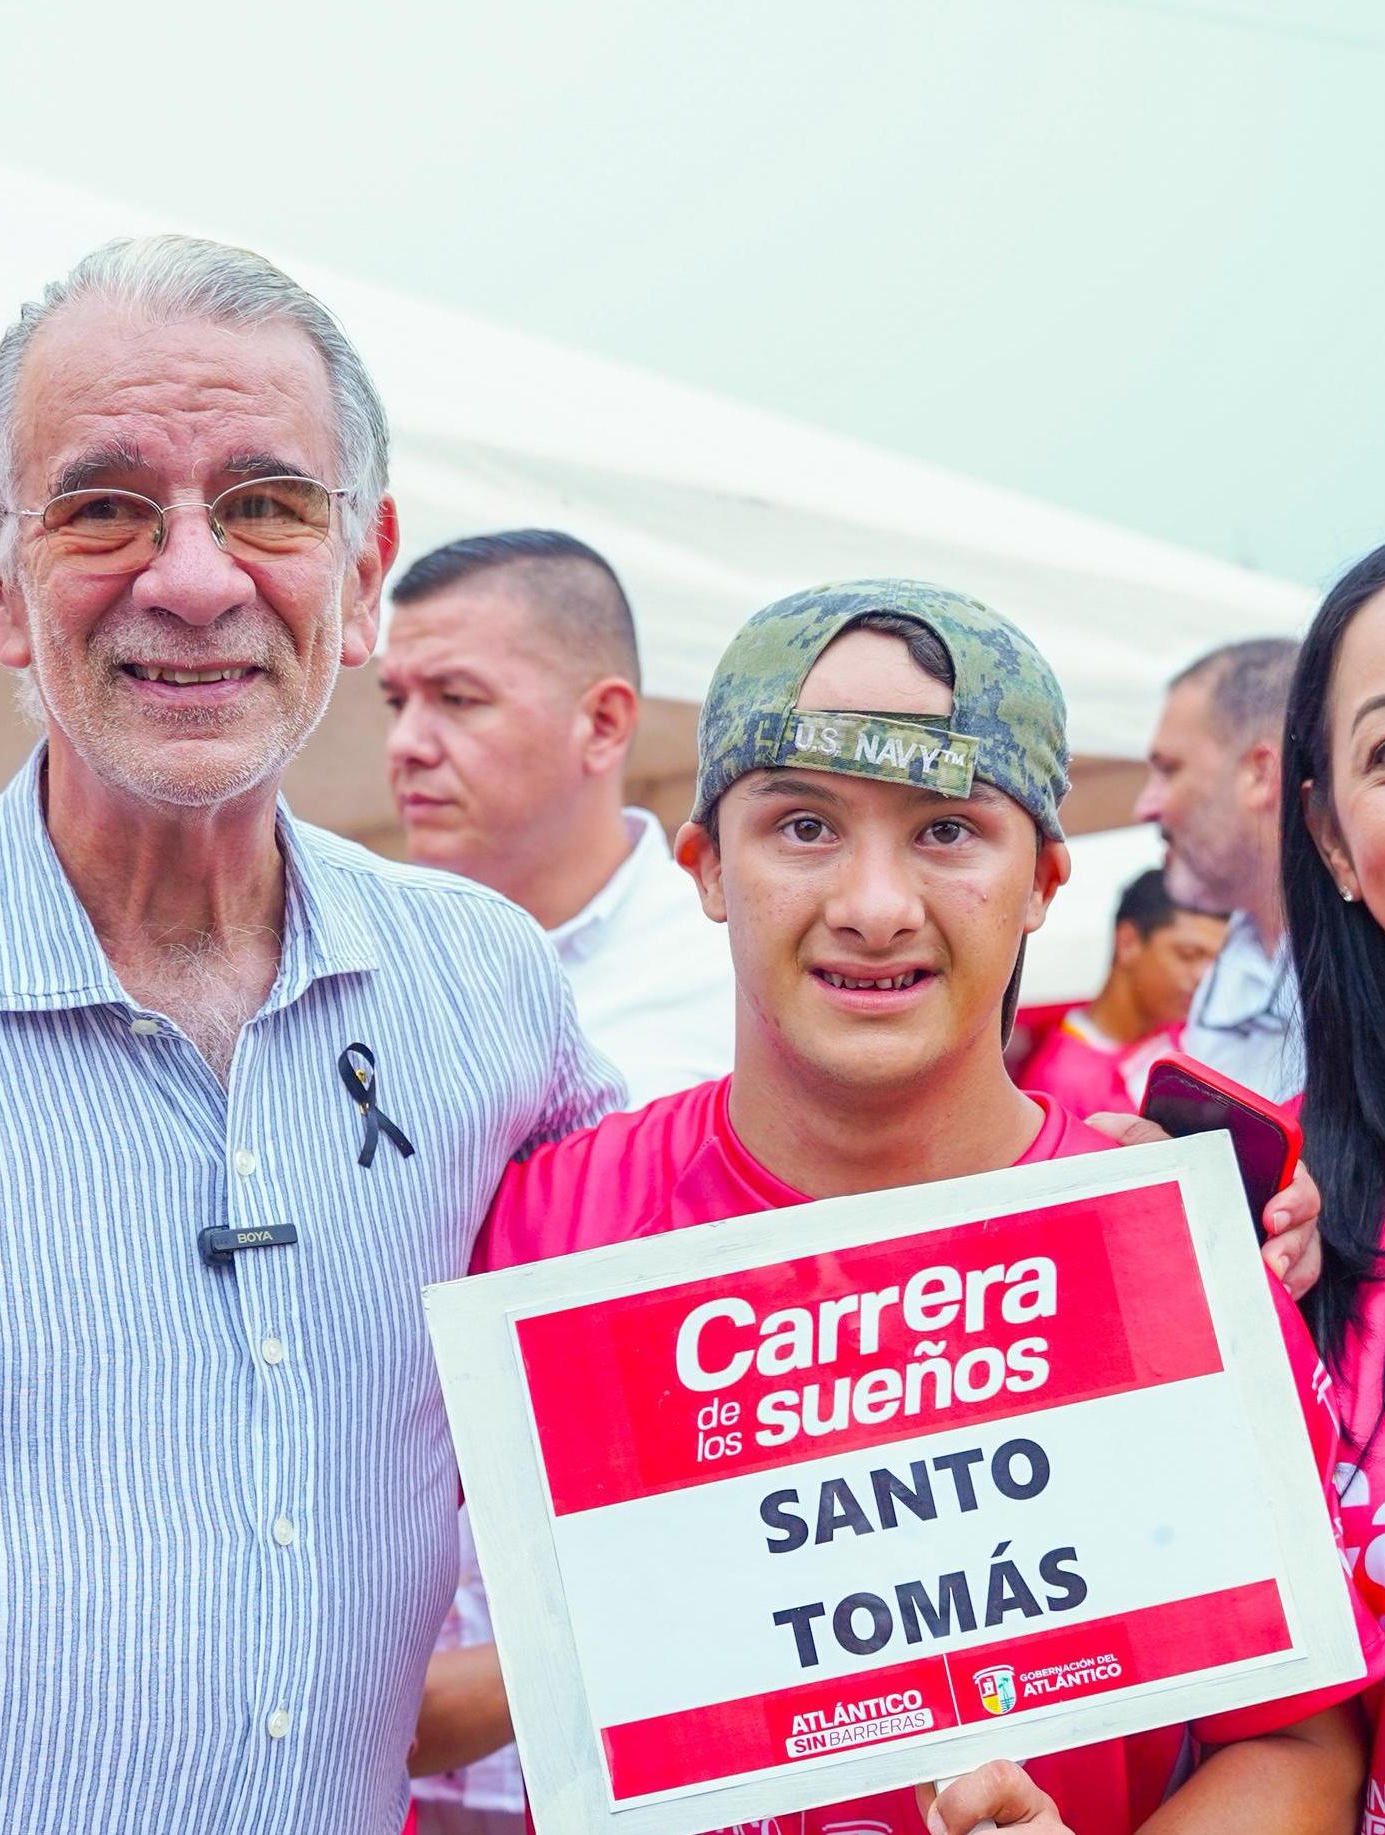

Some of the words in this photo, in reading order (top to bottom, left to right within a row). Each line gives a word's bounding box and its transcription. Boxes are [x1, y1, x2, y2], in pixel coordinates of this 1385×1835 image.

[795, 723, 842, 757] U.S.
[237, 1230, 274, 1244] BOYA
[675, 1256, 1058, 1393] Carrera
[696, 1430, 744, 1463] los
[754, 1336, 1050, 1448] sueños
[697, 1397, 742, 1431] de
[758, 1437, 1052, 1555] SANTO
[772, 1540, 1089, 1669] TOMÁS
[1019, 1656, 1095, 1683] GOBERNACIÓN
[1097, 1653, 1118, 1665] DEL
[1023, 1663, 1122, 1698] ATLÁNTICO
[791, 1689, 923, 1735] ATLÁNTICO
[794, 1737, 827, 1755] SIN
[829, 1712, 927, 1747] BARRERAS
